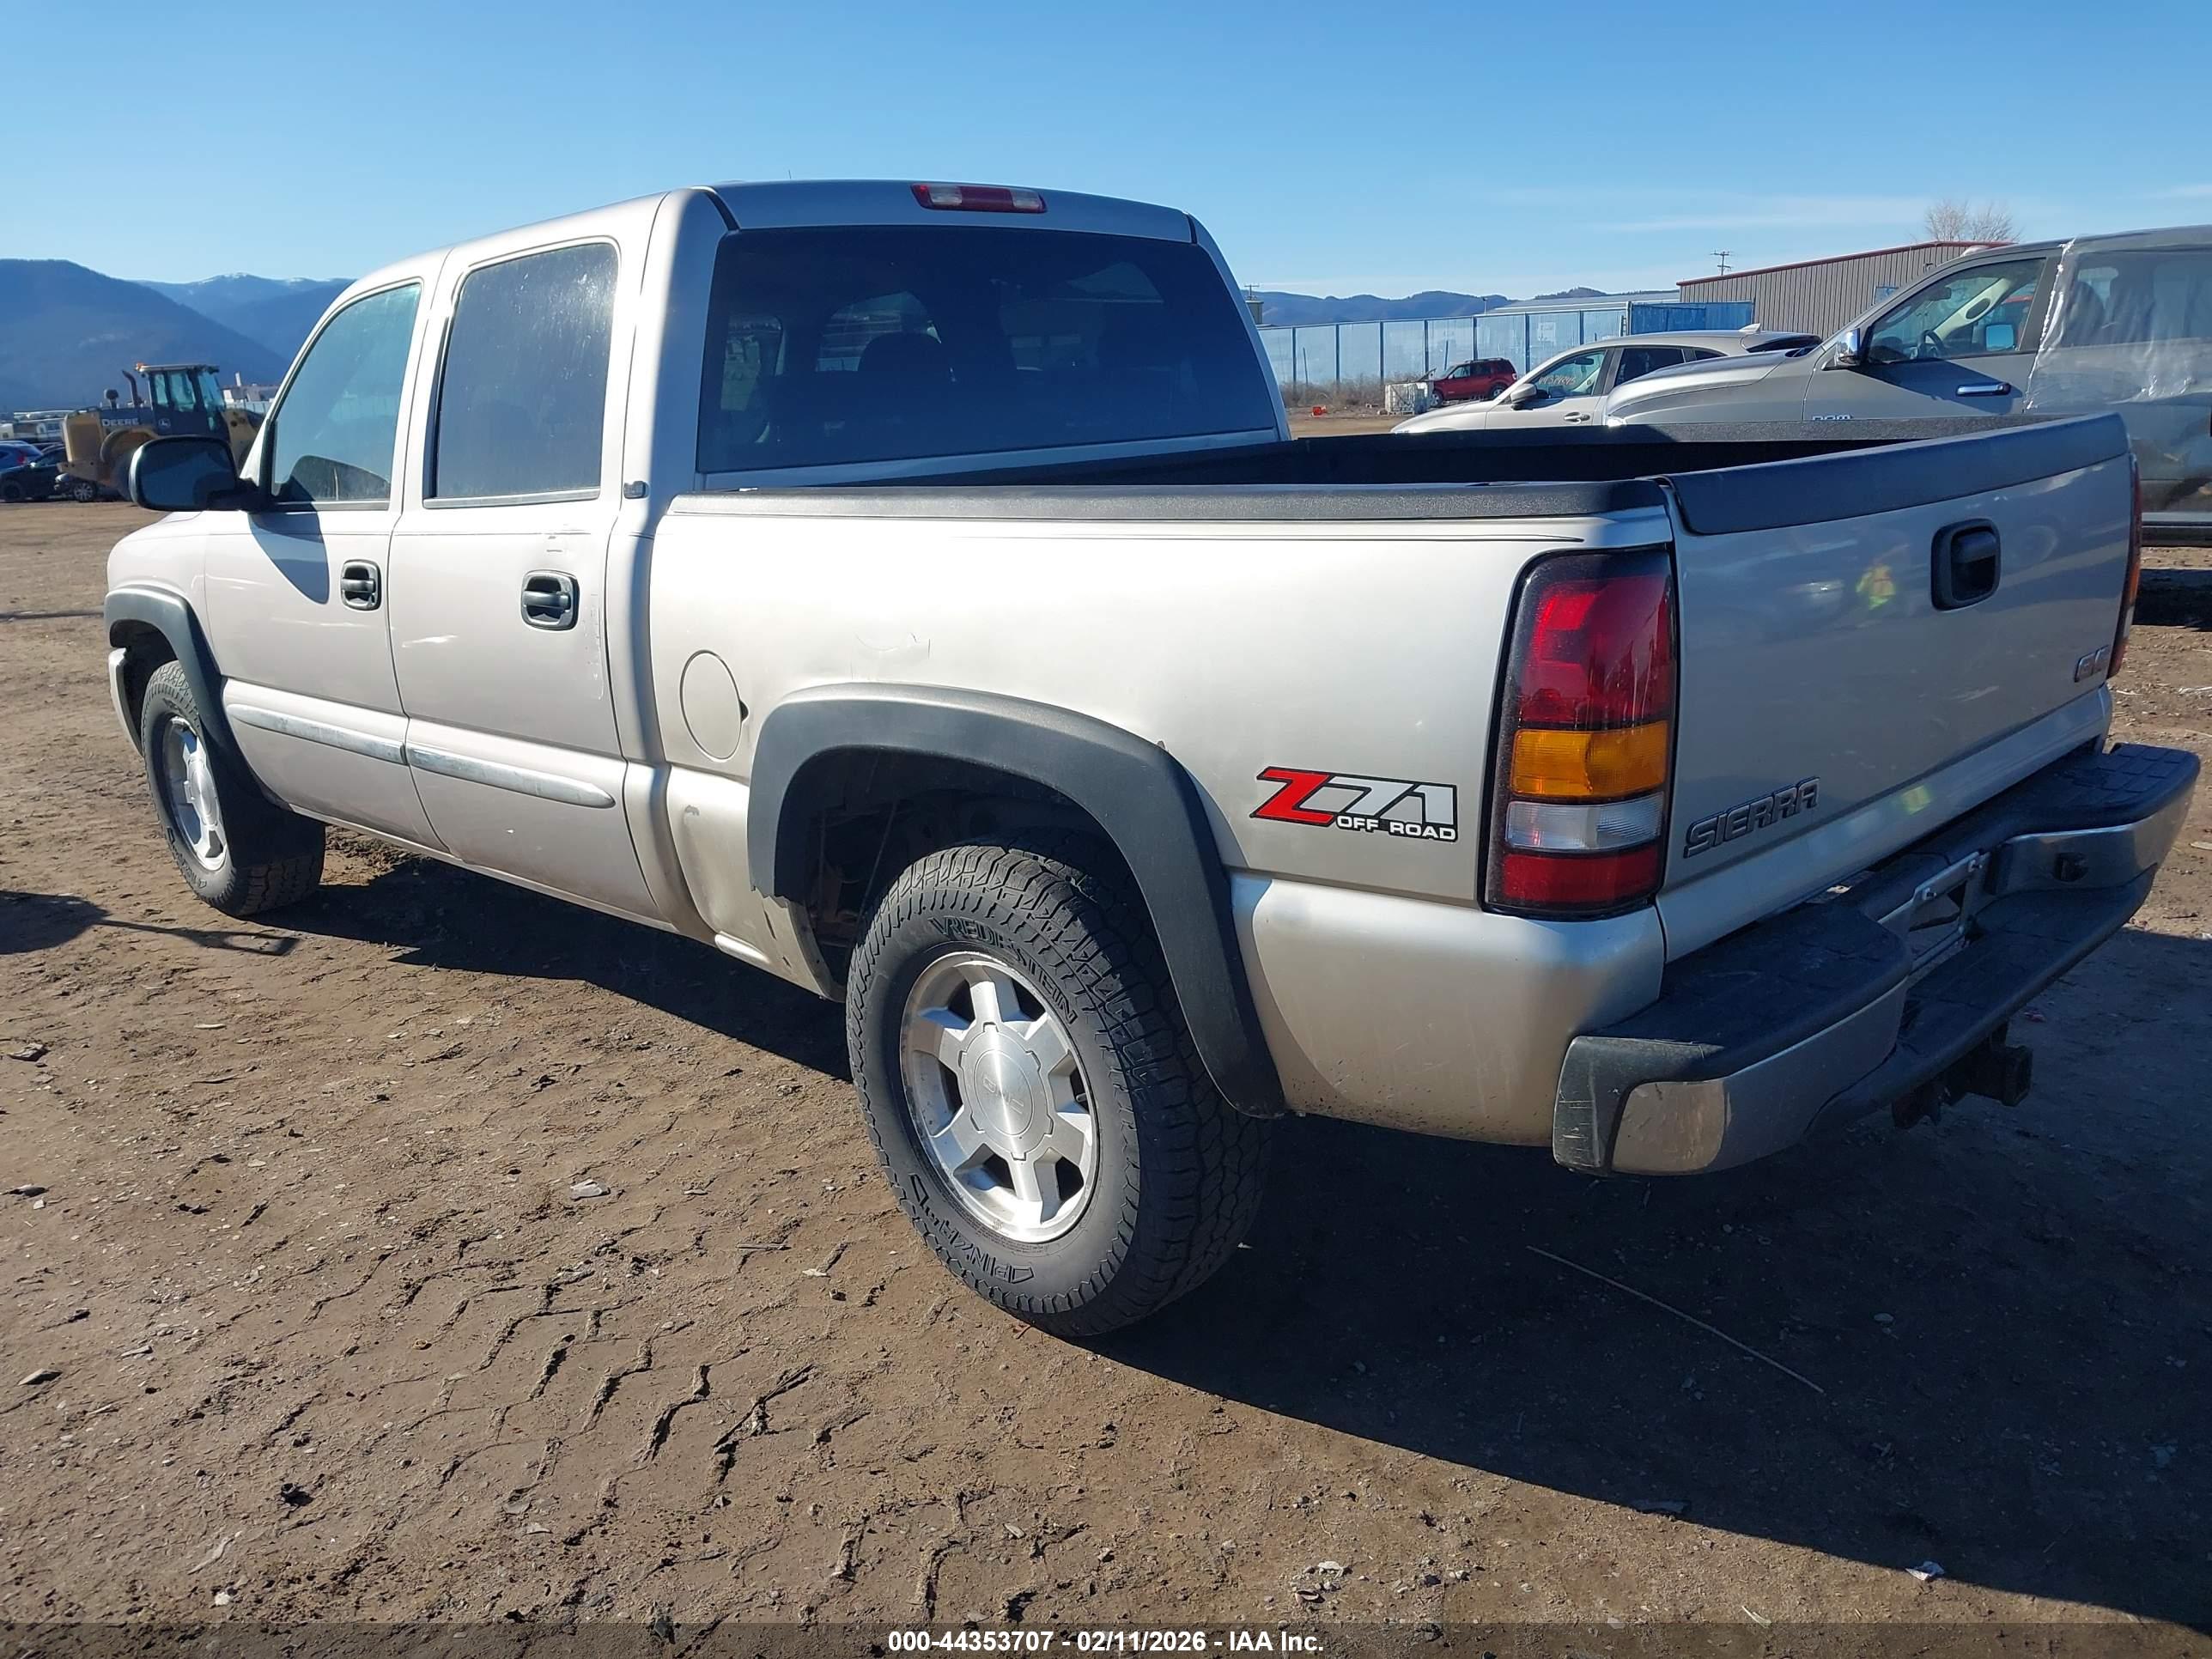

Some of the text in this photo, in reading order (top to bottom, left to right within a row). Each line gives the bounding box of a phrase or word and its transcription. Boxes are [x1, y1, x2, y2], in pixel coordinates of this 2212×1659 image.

[101, 418, 139, 427] DEERE
[1249, 766, 1458, 829] Z71
[1683, 776, 1820, 858] SIERRA
[1335, 814, 1457, 841] OFF ROAD
